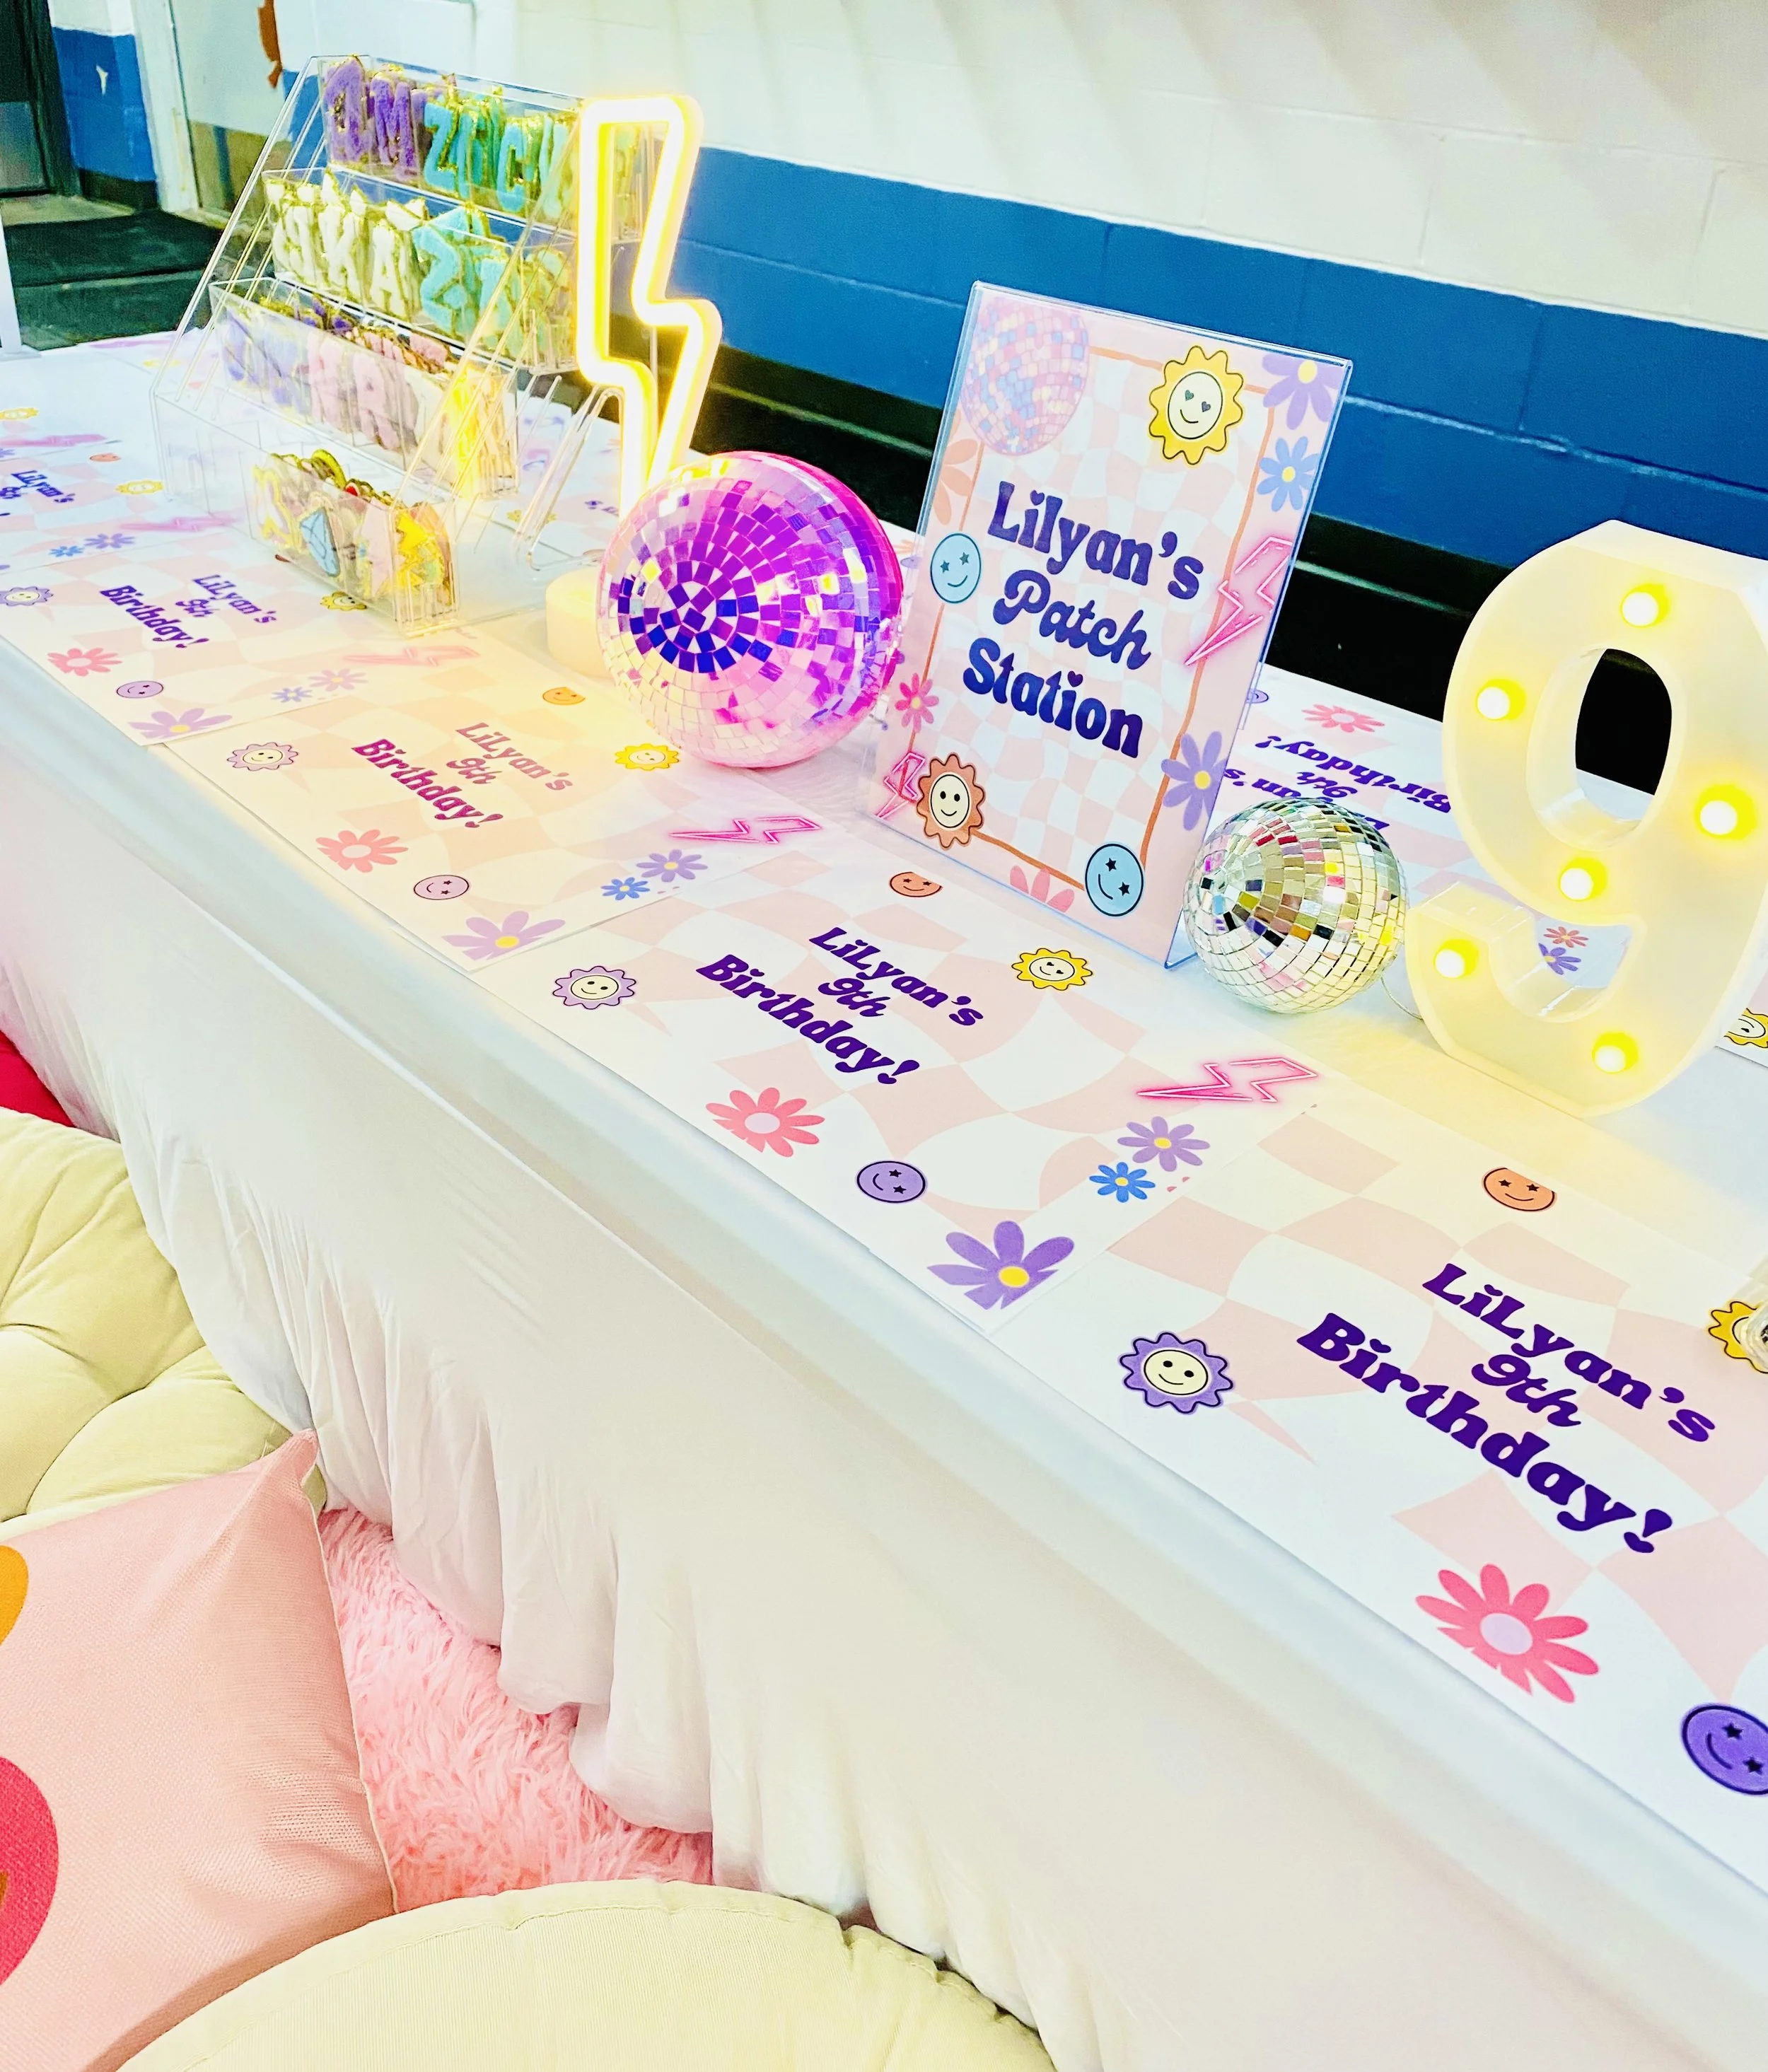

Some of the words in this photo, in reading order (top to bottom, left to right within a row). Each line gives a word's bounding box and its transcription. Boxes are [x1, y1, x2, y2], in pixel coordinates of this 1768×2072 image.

[987, 480, 1204, 600] Lilyan's
[99, 584, 210, 649] Birthday!
[992, 569, 1152, 670] Patch
[962, 636, 1144, 759] Station
[351, 738, 504, 829] Birthday!
[446, 757, 503, 784] 9th
[1254, 735, 1453, 813] Birthday!
[1297, 771, 1359, 799] 9th
[1405, 520, 1768, 1116] 9
[695, 953, 921, 1085] Birthday!
[818, 977, 892, 1018] 9th
[1296, 1312, 1673, 1554] Birthday!
[1470, 1353, 1582, 1428] 9th
